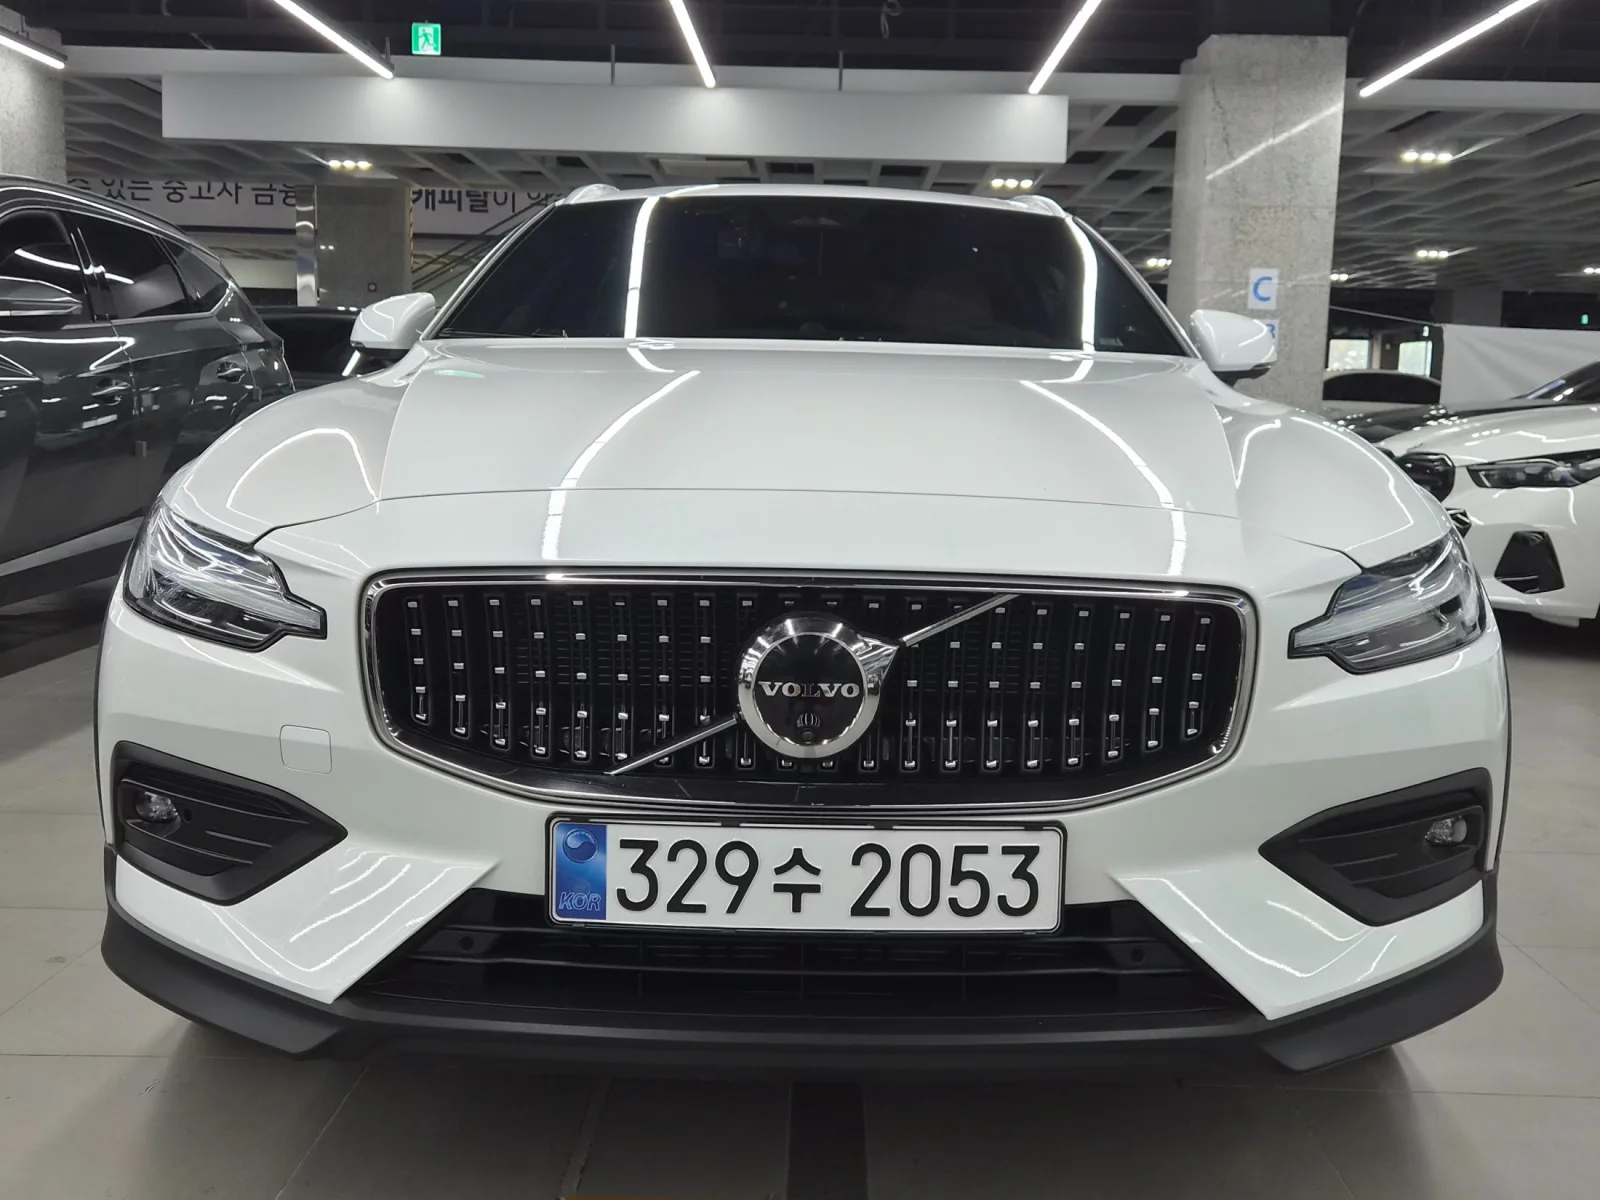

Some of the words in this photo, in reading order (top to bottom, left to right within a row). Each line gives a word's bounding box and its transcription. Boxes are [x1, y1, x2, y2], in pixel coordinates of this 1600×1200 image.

[1252, 276, 1273, 302] C
[758, 681, 860, 698] VOLVO
[616, 838, 822, 914] 329수
[850, 842, 1041, 918] 2053
[558, 891, 602, 912] KOR
